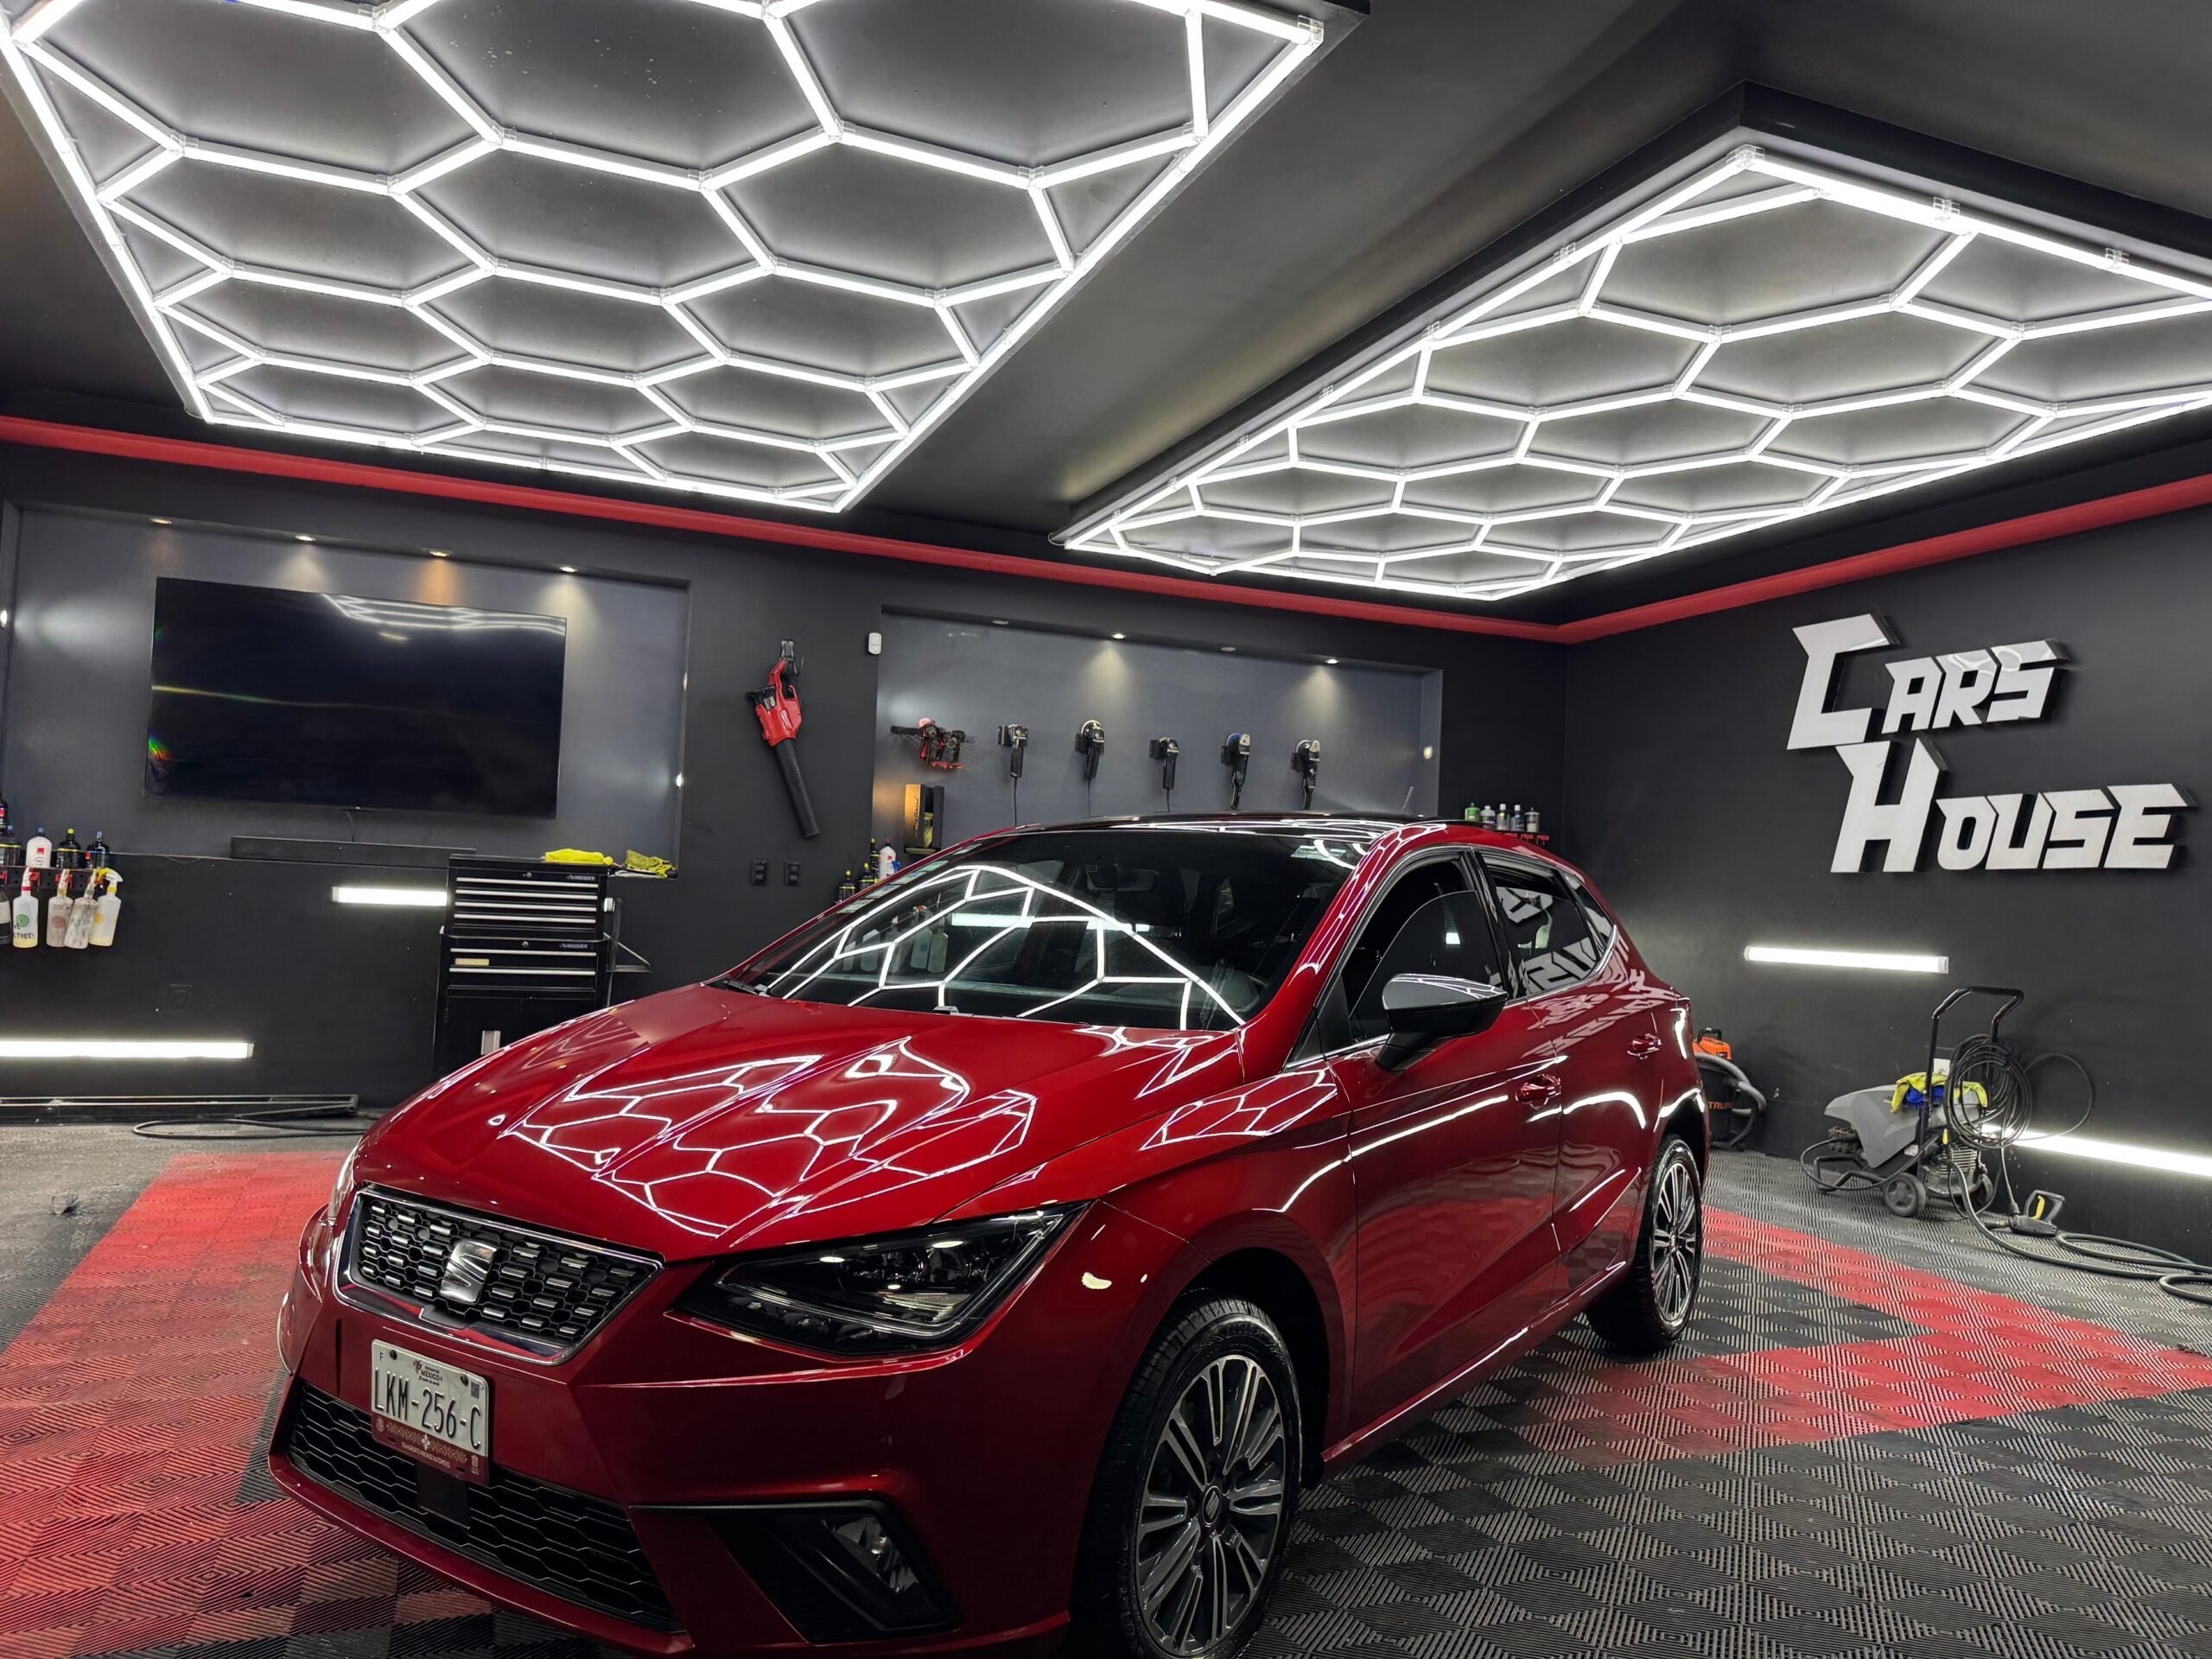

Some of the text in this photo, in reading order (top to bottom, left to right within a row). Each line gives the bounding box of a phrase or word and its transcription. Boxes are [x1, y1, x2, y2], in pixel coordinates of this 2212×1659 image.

[1786, 613, 2067, 750] CARS
[1829, 738, 2195, 873] HOUSE
[374, 1367, 482, 1450] LKM-256-C
[379, 1351, 384, 1361] F
